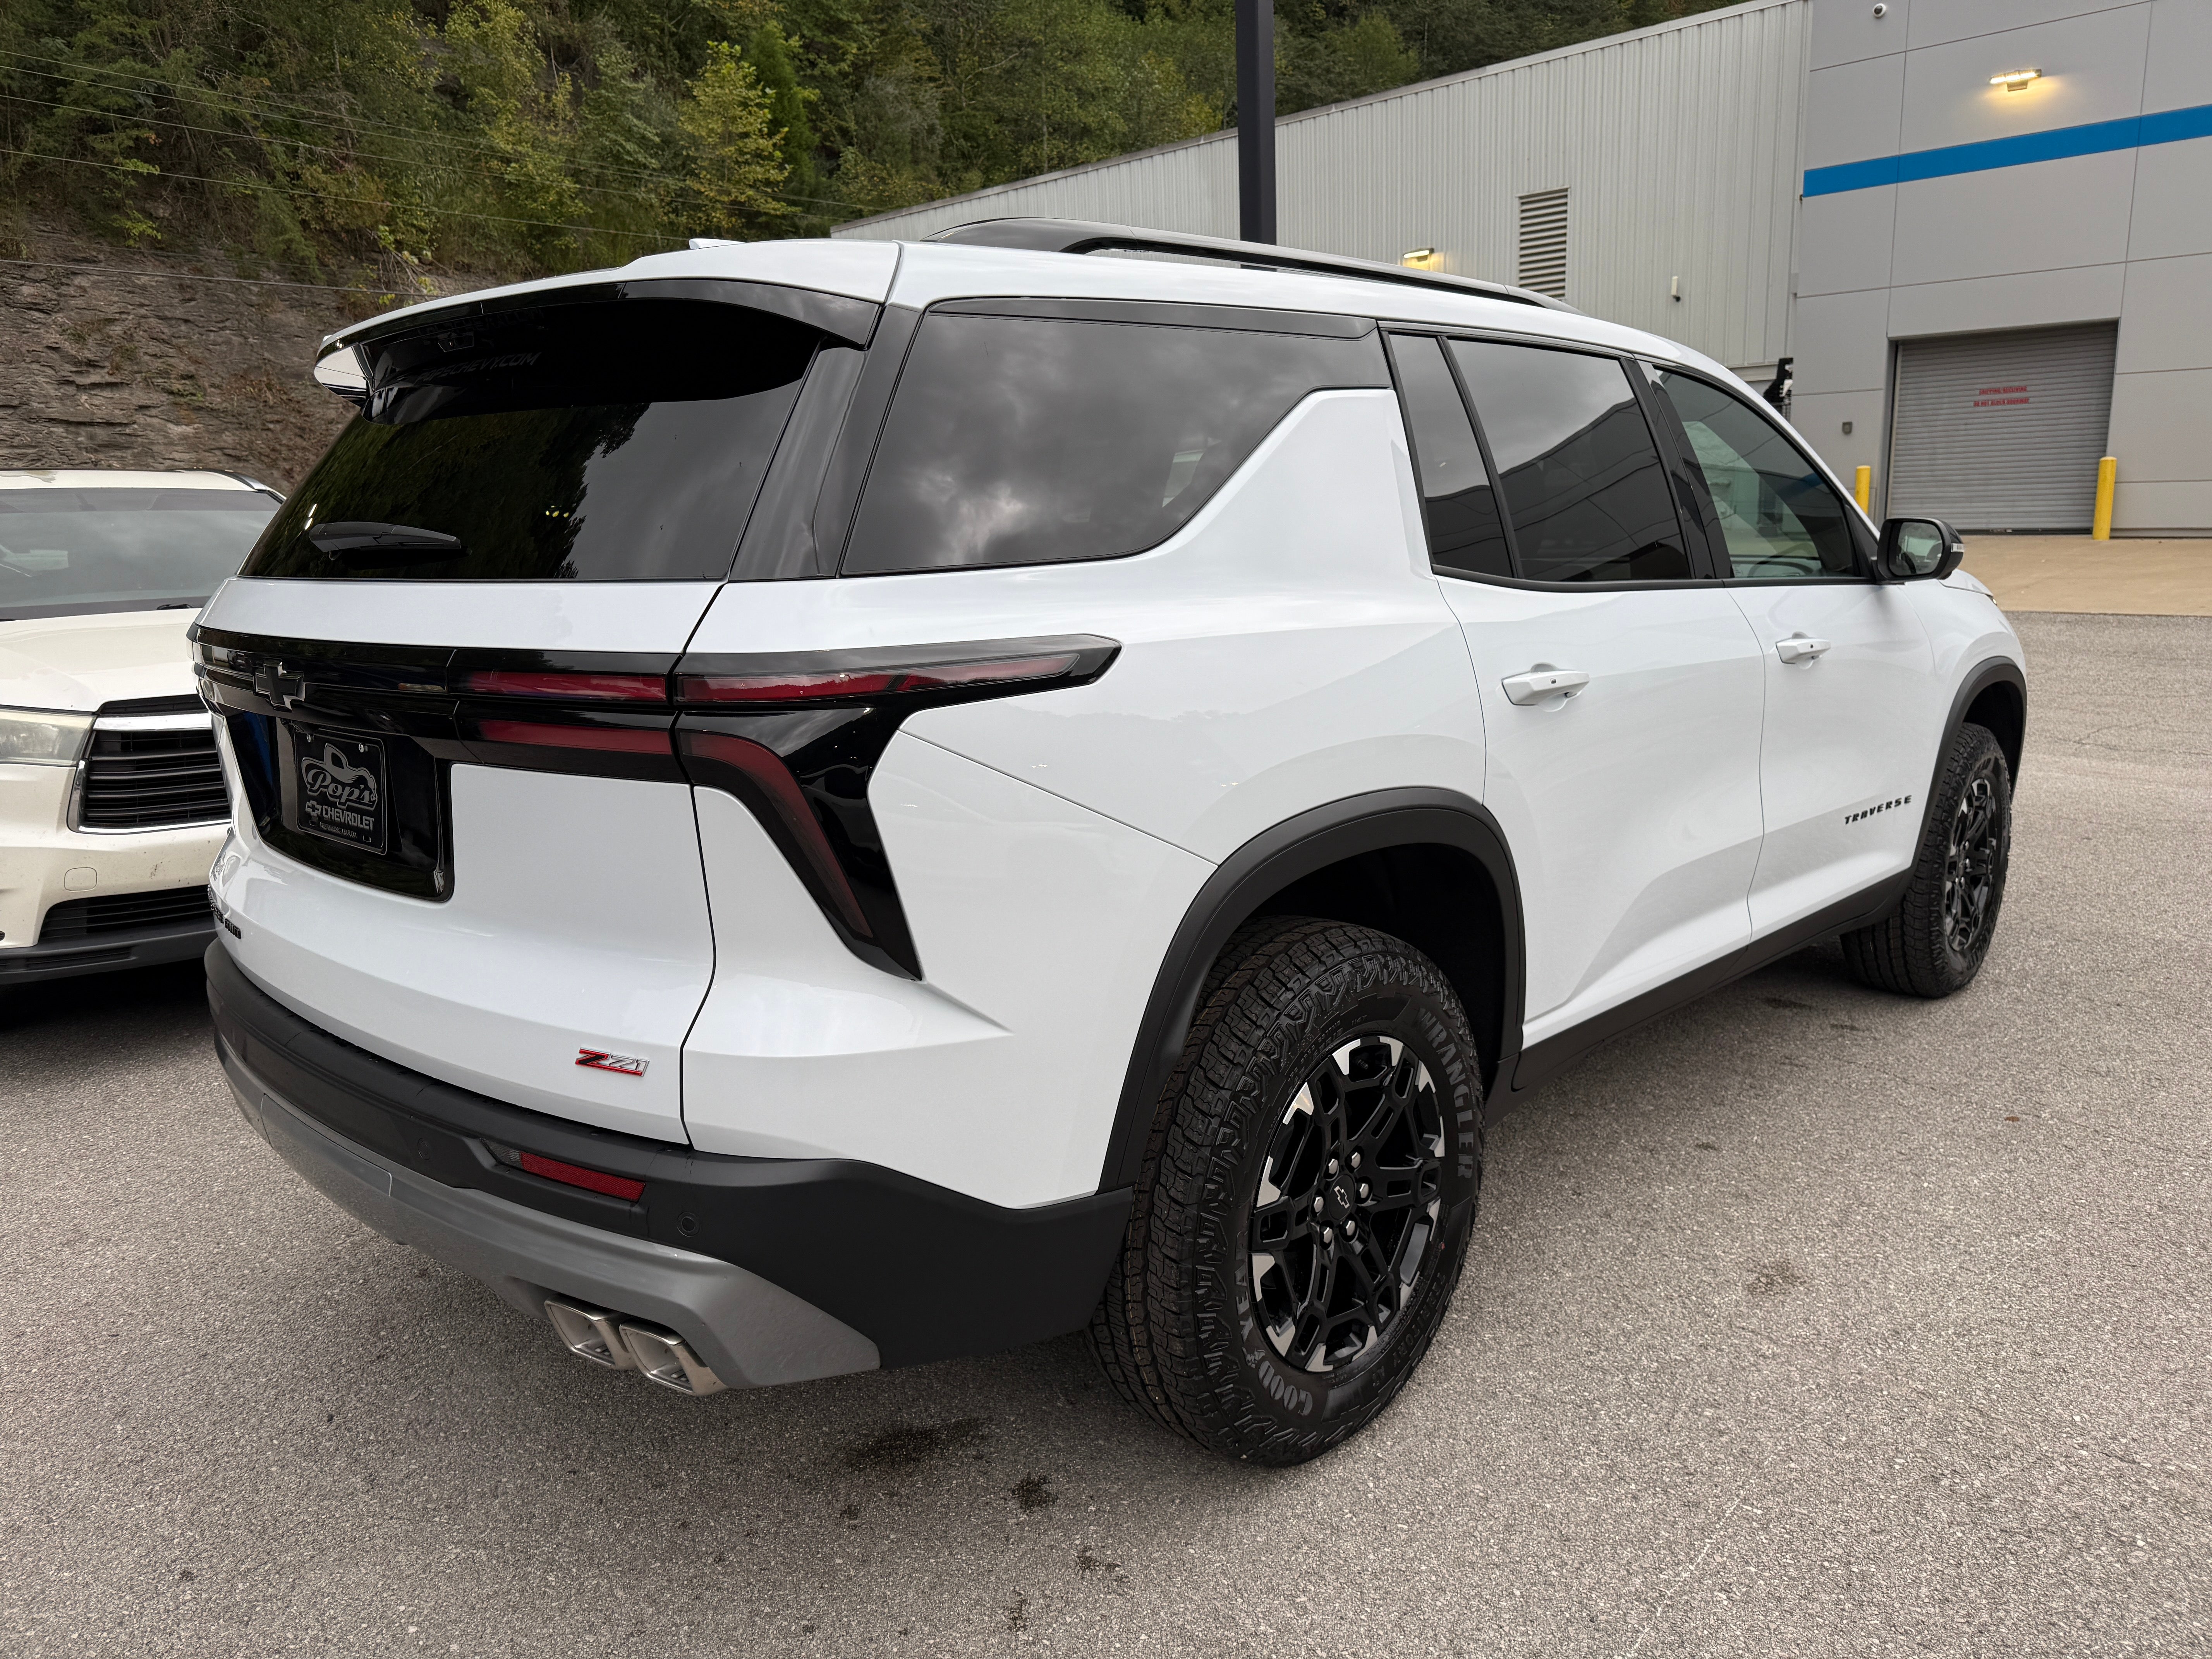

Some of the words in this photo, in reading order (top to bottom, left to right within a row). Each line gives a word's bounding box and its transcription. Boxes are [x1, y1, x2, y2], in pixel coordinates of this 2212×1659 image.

[307, 769, 373, 804] Pop's
[323, 805, 374, 831] CHEVROLET
[1844, 795, 1912, 825] TRAVERSE
[575, 1047, 650, 1077] Z71
[1415, 1006, 1474, 1179] WRANGLER
